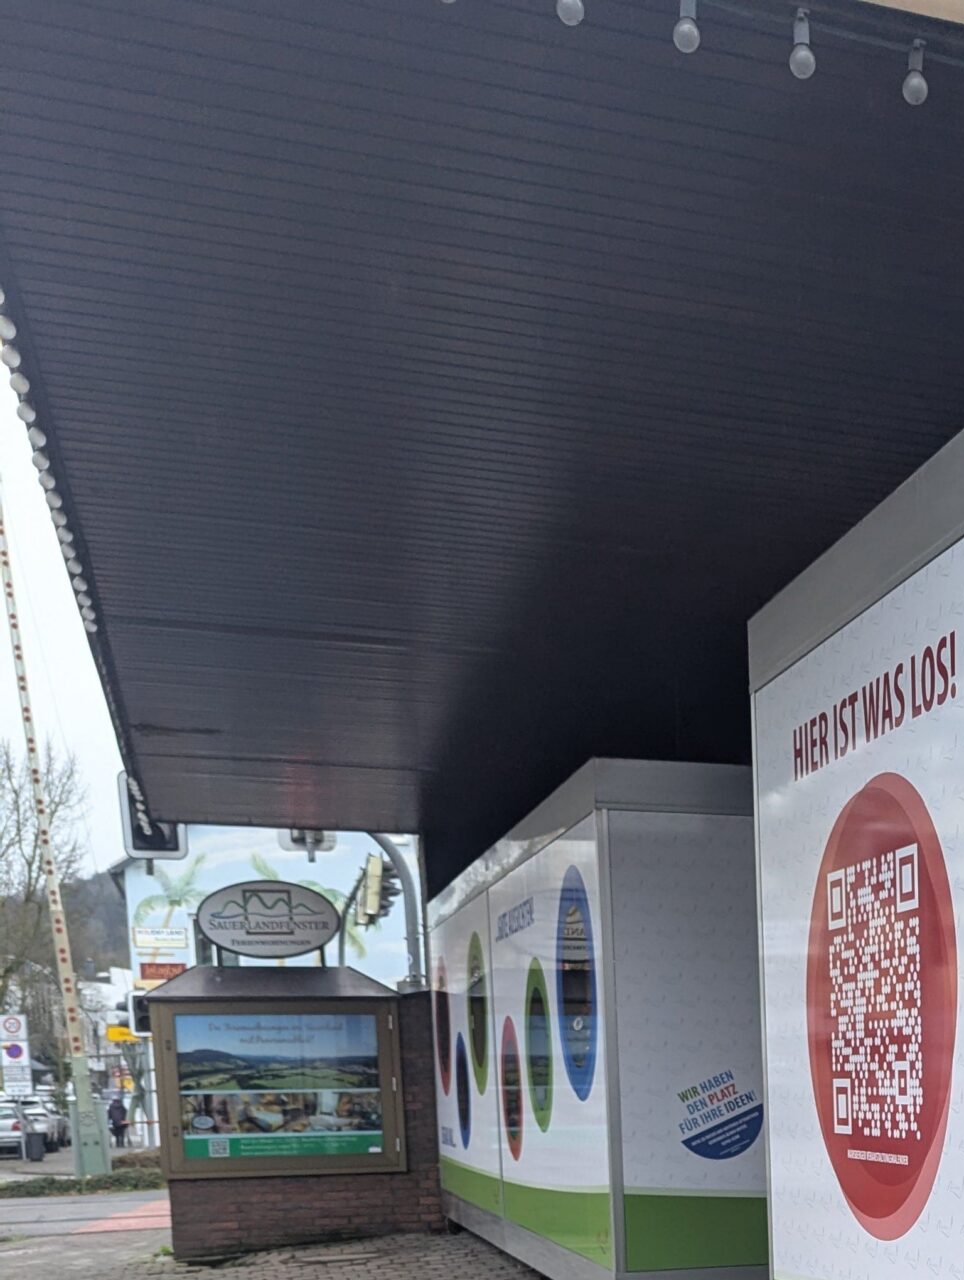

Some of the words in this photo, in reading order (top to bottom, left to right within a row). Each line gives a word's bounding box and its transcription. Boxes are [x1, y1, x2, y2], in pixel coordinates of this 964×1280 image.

[793, 712, 830, 782] HIER
[833, 691, 858, 761] IST
[862, 663, 905, 744] WAS
[910, 630, 957, 719] LOS!
[677, 1086, 700, 1103] WIR
[699, 1070, 734, 1094] HABEN
[686, 1098, 708, 1115] DEN
[707, 1083, 738, 1105] PLATZ
[679, 1117, 700, 1135] FÜR
[699, 1106, 725, 1125] IHRE
[723, 1089, 757, 1114] IDEEN!
